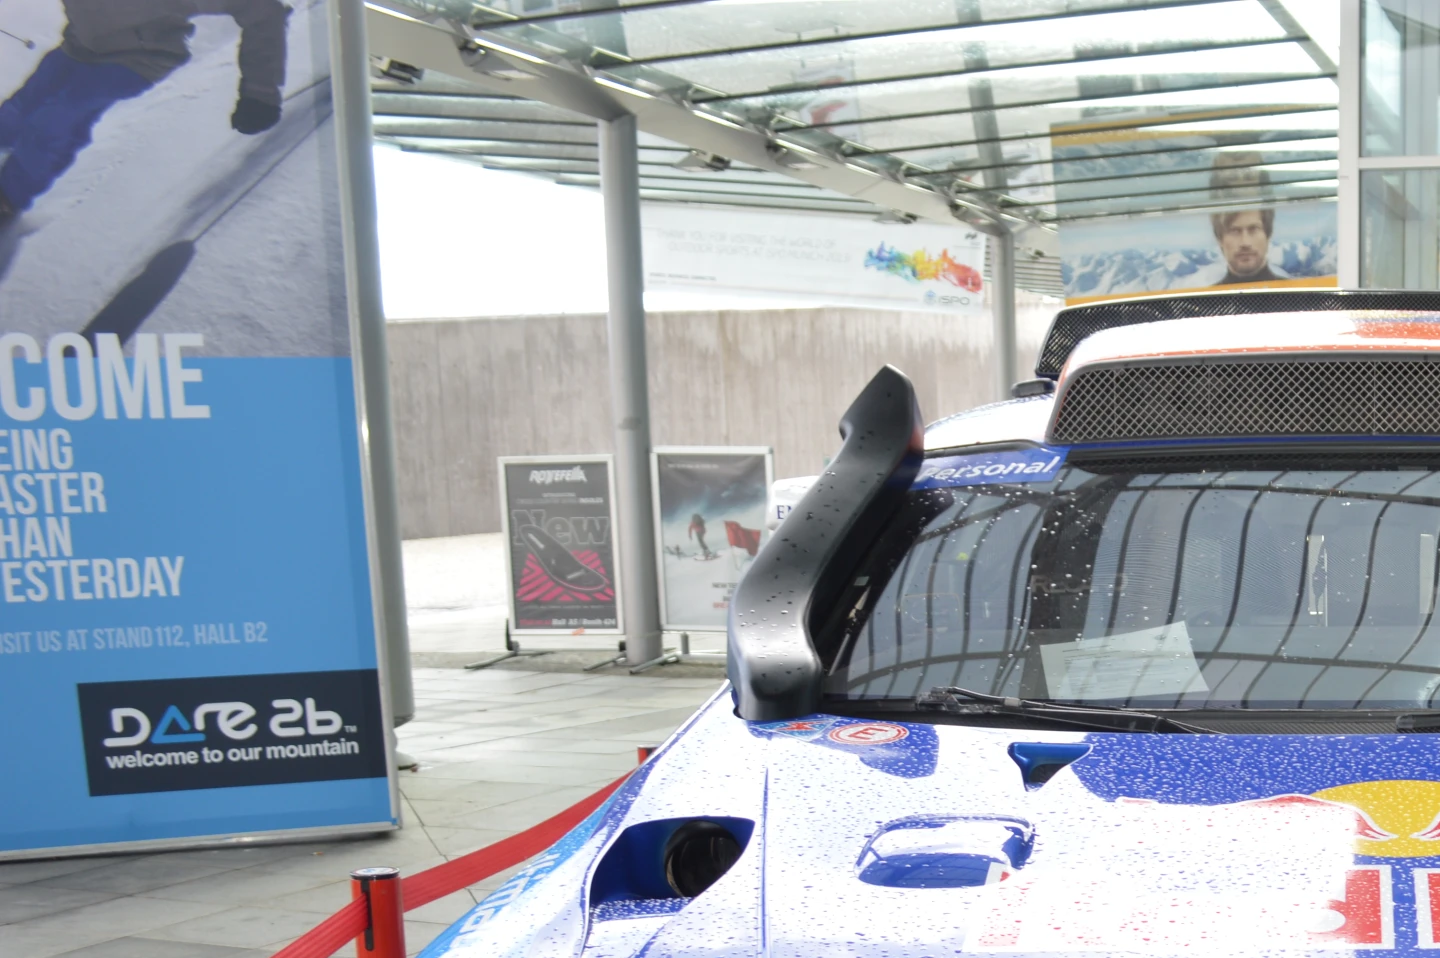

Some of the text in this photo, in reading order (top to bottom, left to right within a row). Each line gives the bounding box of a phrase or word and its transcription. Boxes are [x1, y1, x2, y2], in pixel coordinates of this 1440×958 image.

[0, 332, 211, 421] COME
[914, 456, 1060, 481] Personal
[2, 556, 184, 602] ESTERDAY
[36, 630, 61, 652] US
[67, 629, 88, 651] AT
[93, 626, 152, 650] STAND
[194, 623, 240, 645] HALL
[244, 621, 268, 643] B2
[106, 738, 359, 769] welcome to our mountain
